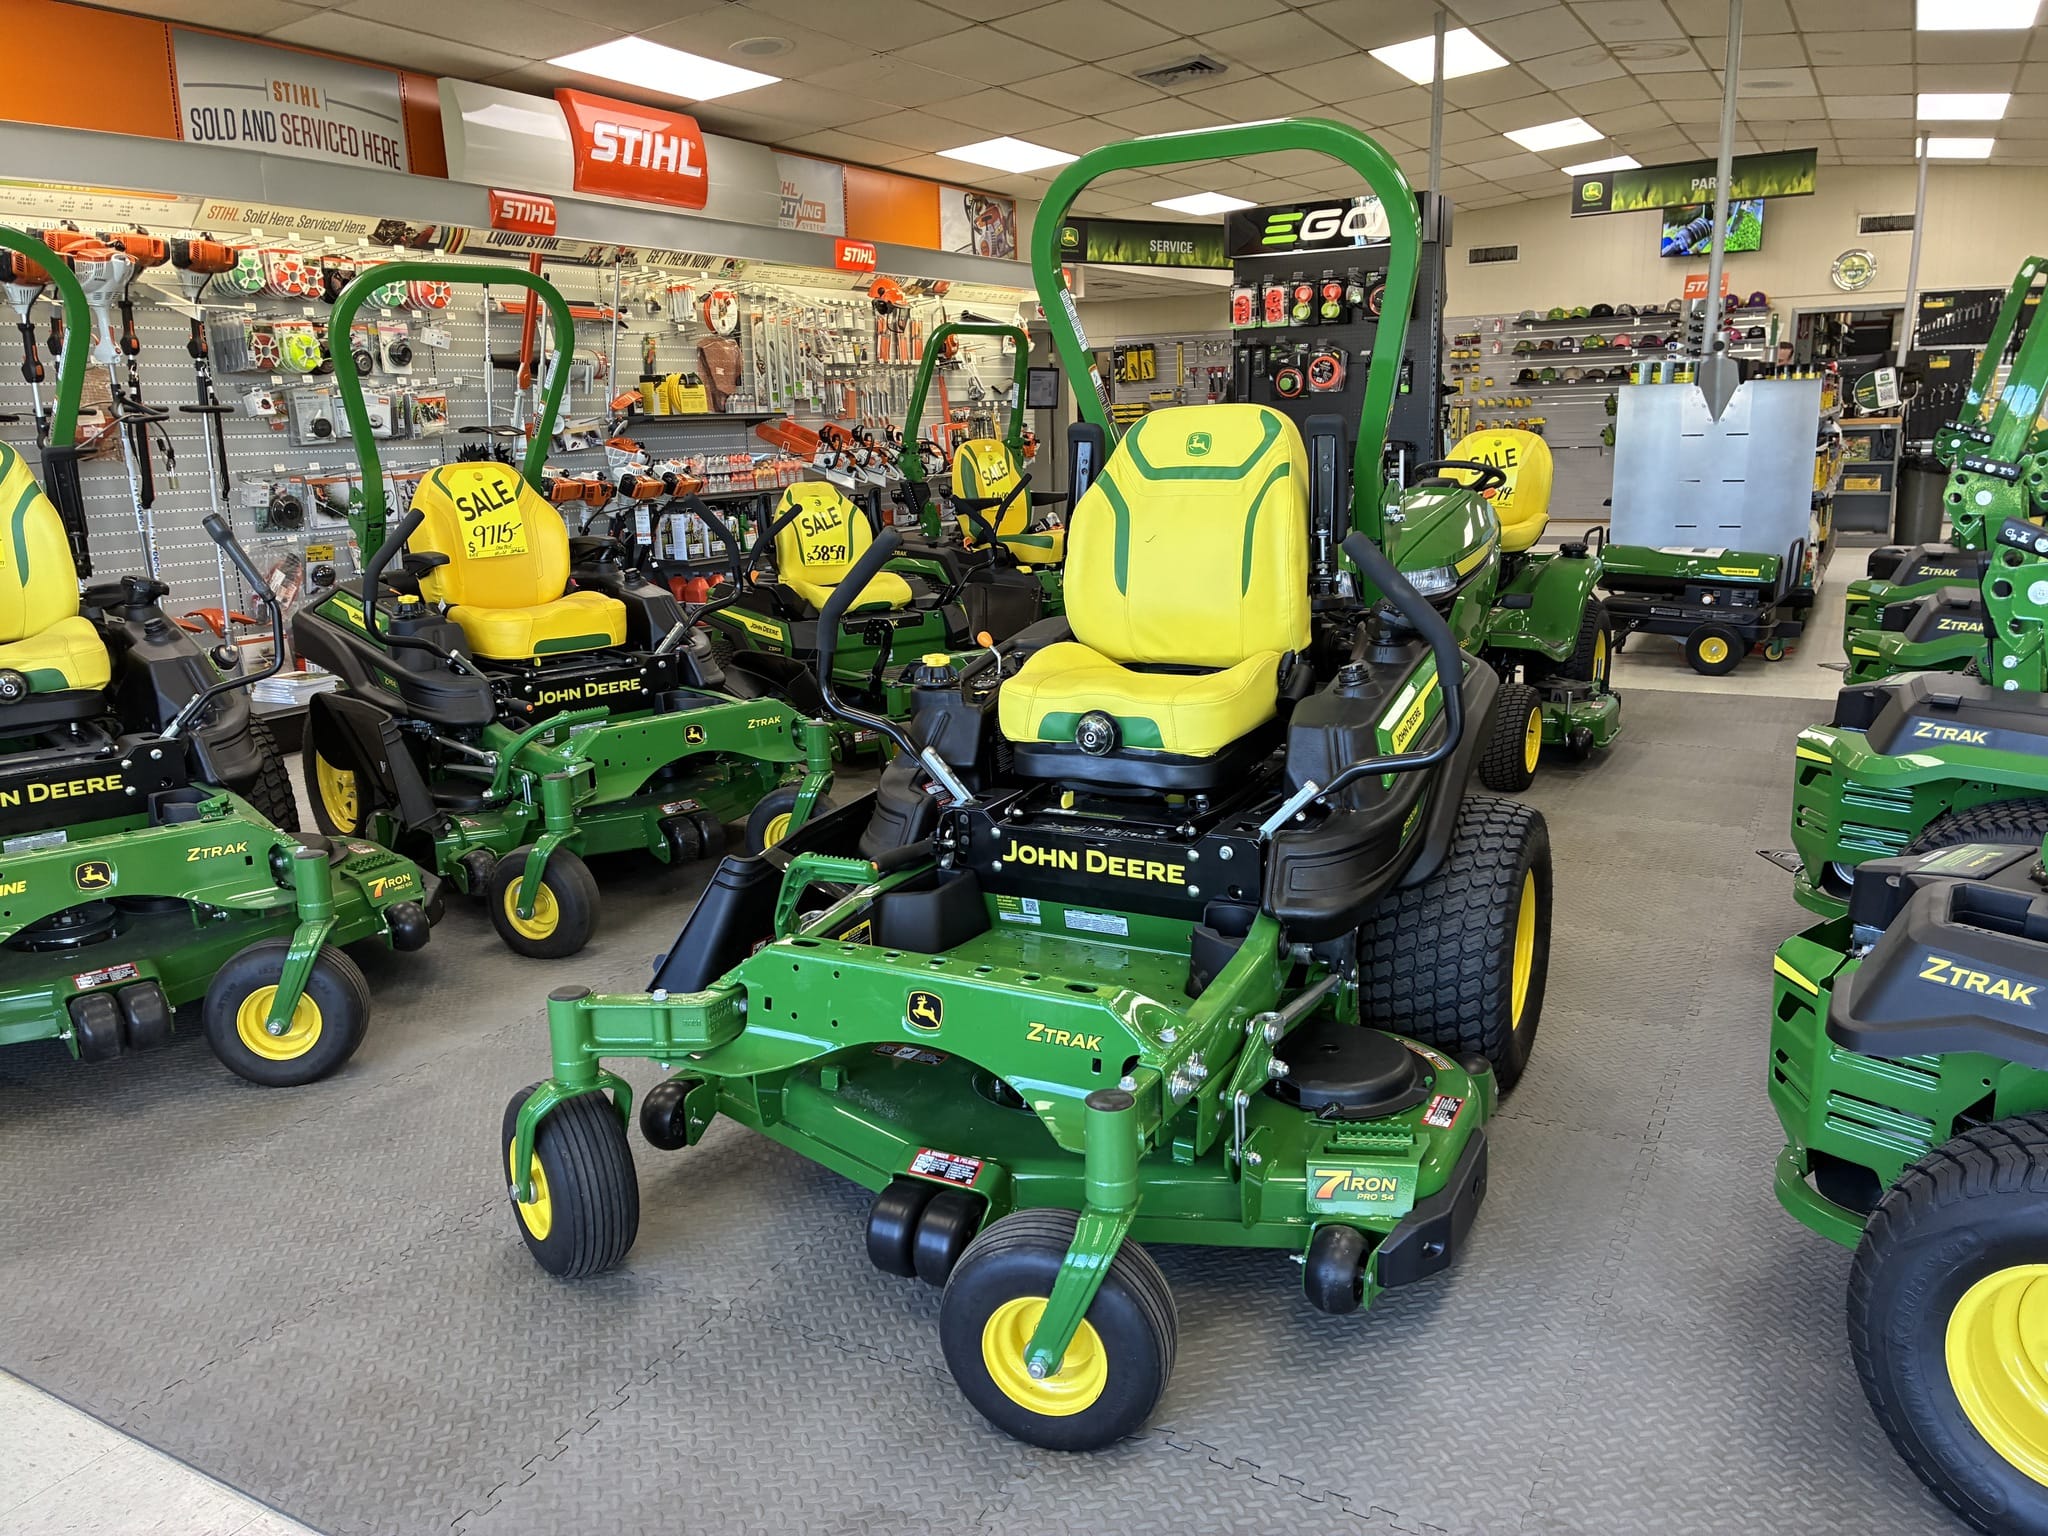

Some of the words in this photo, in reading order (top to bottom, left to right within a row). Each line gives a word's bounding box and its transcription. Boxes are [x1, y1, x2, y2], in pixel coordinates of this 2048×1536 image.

[272, 80, 320, 109] STIHL
[190, 107, 238, 141] SOLD
[242, 109, 277, 143] AND
[280, 113, 359, 158] SERVICED
[361, 129, 402, 171] HERE
[591, 120, 702, 177] STIHL
[243, 208, 267, 225] Sold
[268, 212, 294, 228] Here.
[297, 215, 341, 232] Serviced
[342, 221, 366, 235] Here.
[500, 200, 555, 225] STIHL
[1261, 207, 1391, 246] EGO
[486, 231, 527, 248] LIQUID
[526, 236, 560, 251] STIHL
[1150, 239, 1193, 254] SERVICE
[646, 249, 666, 265] GET
[665, 251, 691, 268] THEM
[690, 254, 716, 270] NOW!
[842, 247, 876, 265] STIHL
[982, 460, 1008, 487] SALE
[456, 480, 515, 521] SALE
[802, 506, 842, 538] SALE
[1918, 566, 1959, 577] ZTRAK
[750, 622, 763, 633] JOHN
[762, 624, 780, 636] DEERE
[534, 687, 582, 706] JOHN
[585, 678, 641, 698] DEERE
[748, 715, 782, 729] ZTRAK
[1396, 728, 1409, 747] JOHN
[1406, 706, 1422, 732] DEERE
[1914, 721, 1989, 744] ZTRAK
[27, 774, 124, 803] DEERE
[186, 841, 249, 862] ZTRAK
[1002, 839, 1079, 871] JOHN
[1086, 849, 1186, 885] DEERE
[1919, 956, 2038, 1006] ZTRAK
[1027, 1022, 1103, 1052] ZTRAK
[1357, 1192, 1378, 1201] PRO
[1381, 1193, 1395, 1201] 54
